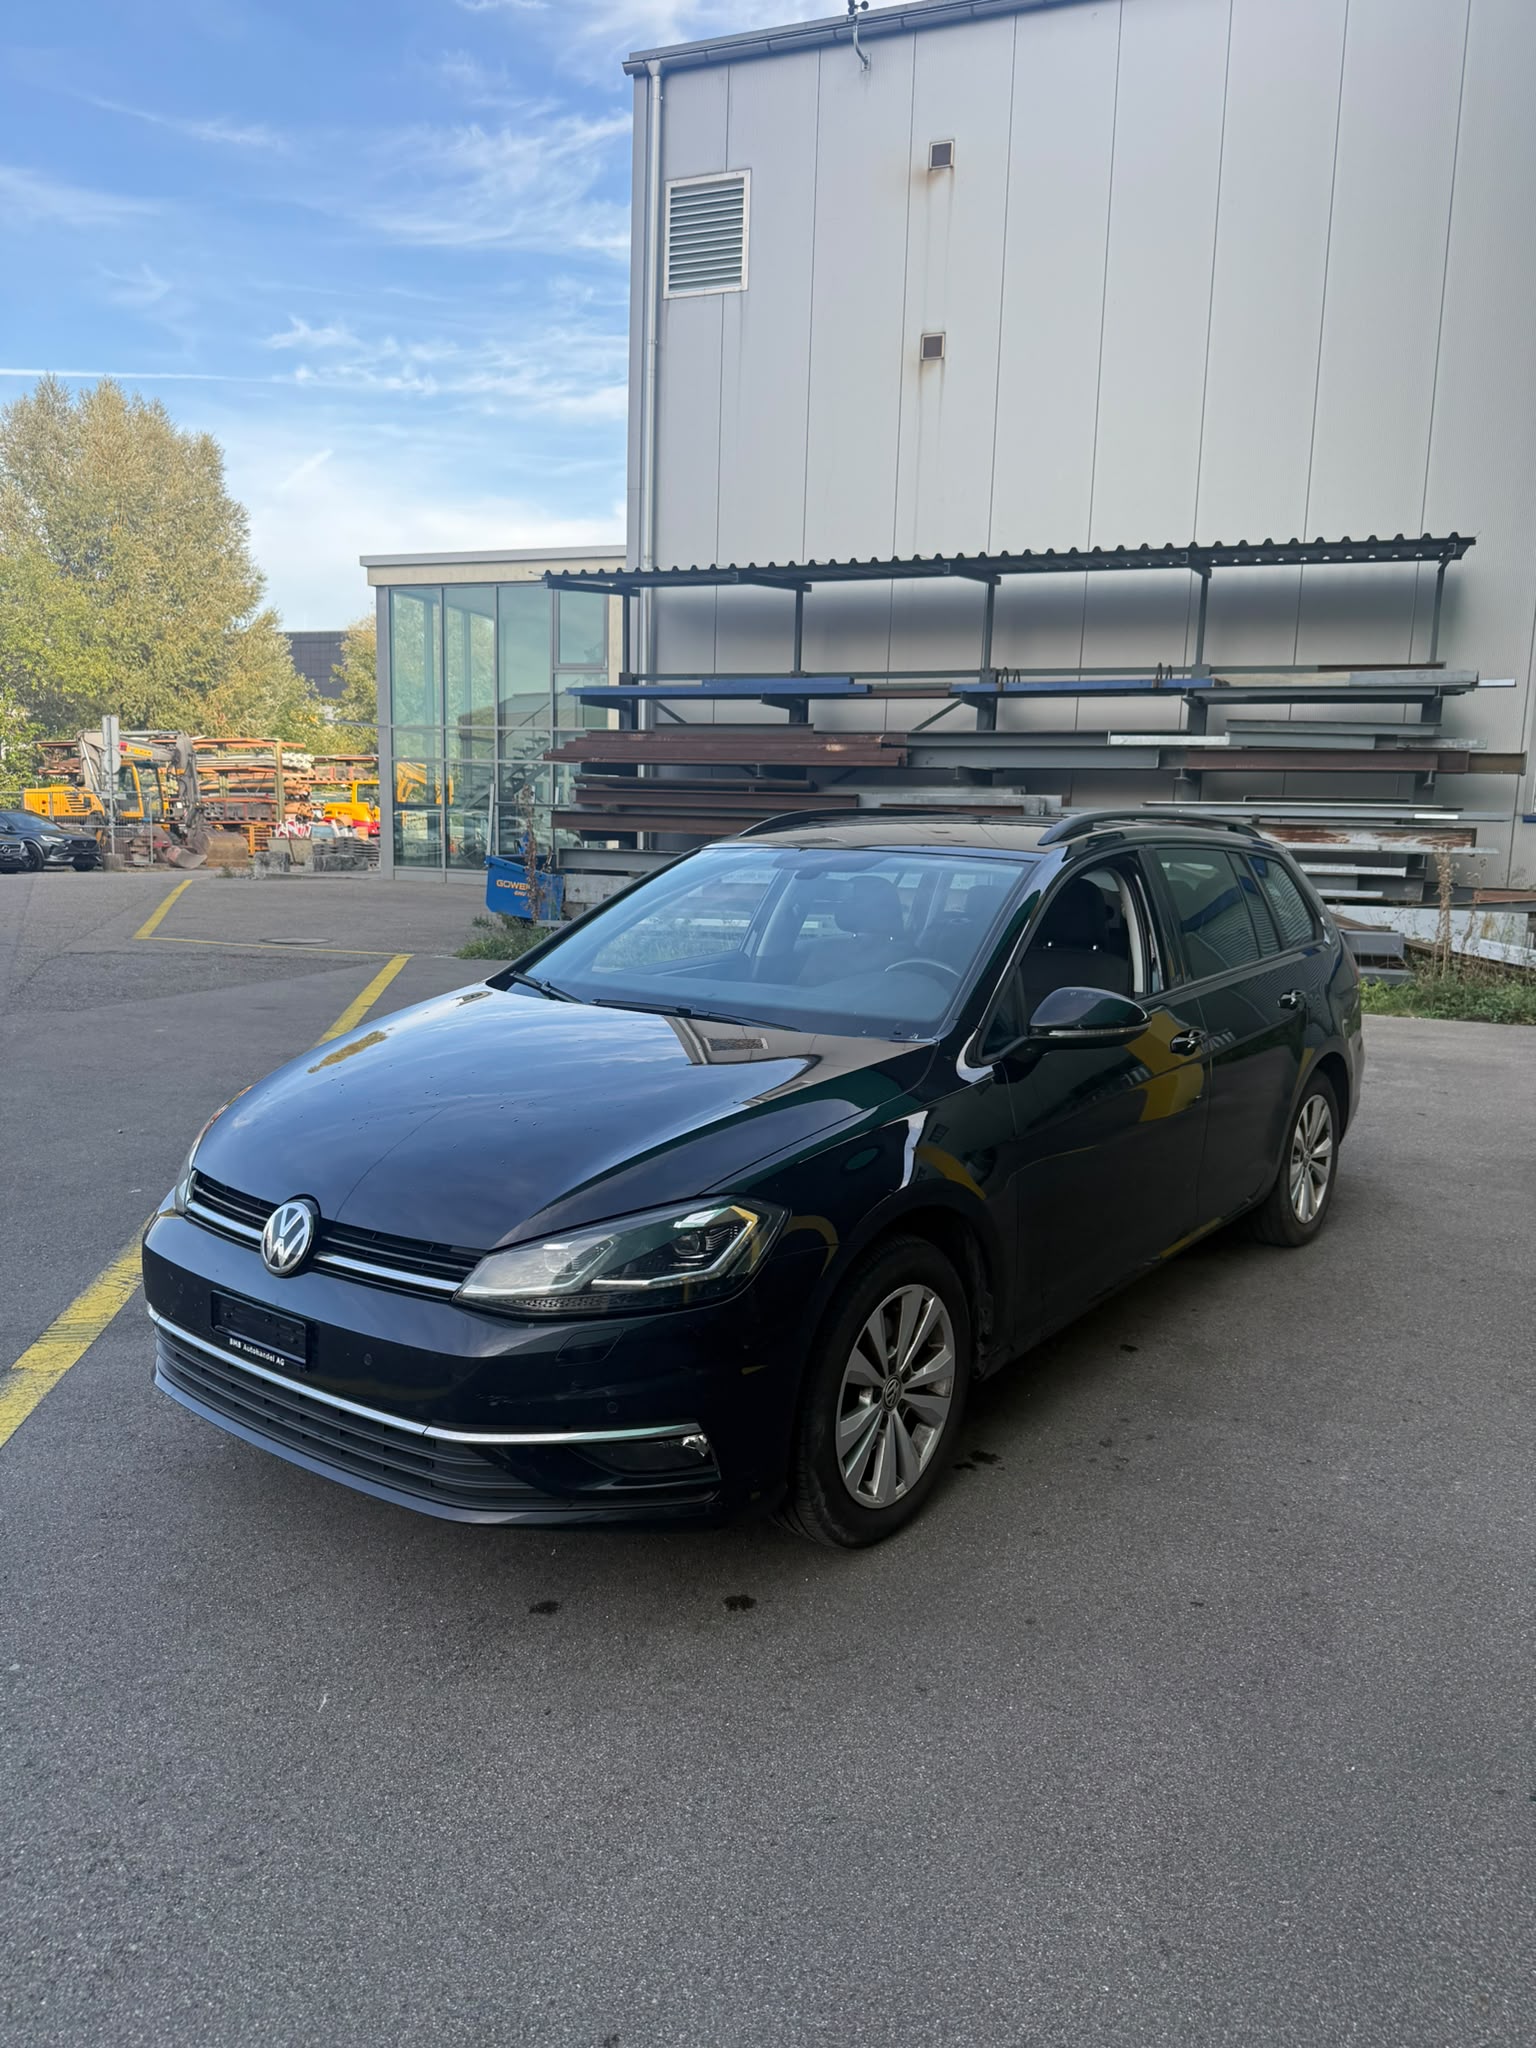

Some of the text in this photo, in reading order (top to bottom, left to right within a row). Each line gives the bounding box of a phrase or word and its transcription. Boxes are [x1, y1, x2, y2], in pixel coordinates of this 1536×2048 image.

[262, 1203, 310, 1271] VW
[243, 1344, 275, 1362] Autohandel
[275, 1356, 285, 1366] AG
